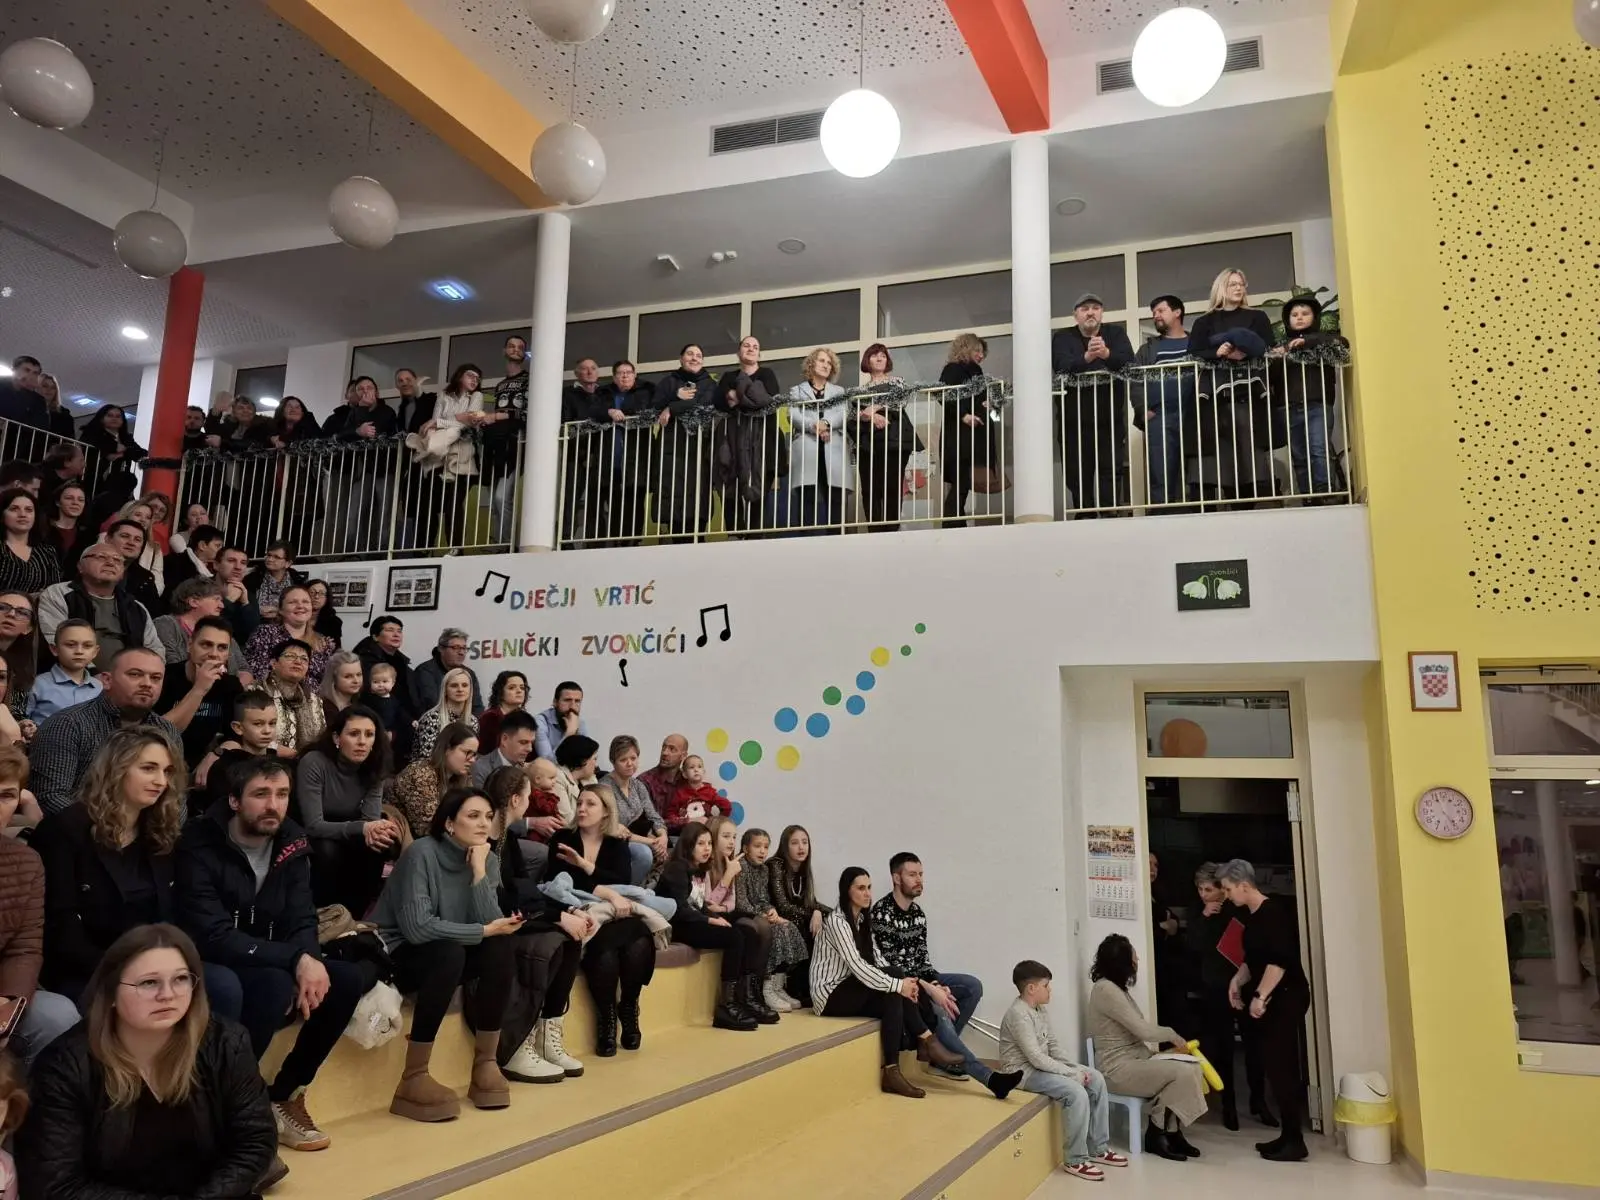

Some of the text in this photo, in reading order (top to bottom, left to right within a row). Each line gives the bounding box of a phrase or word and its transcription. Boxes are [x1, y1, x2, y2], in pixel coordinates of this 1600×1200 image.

[510, 580, 656, 610] DJEČJI VRTIĆ
[469, 626, 685, 660] SELNIČKI ZVONČIĆI
